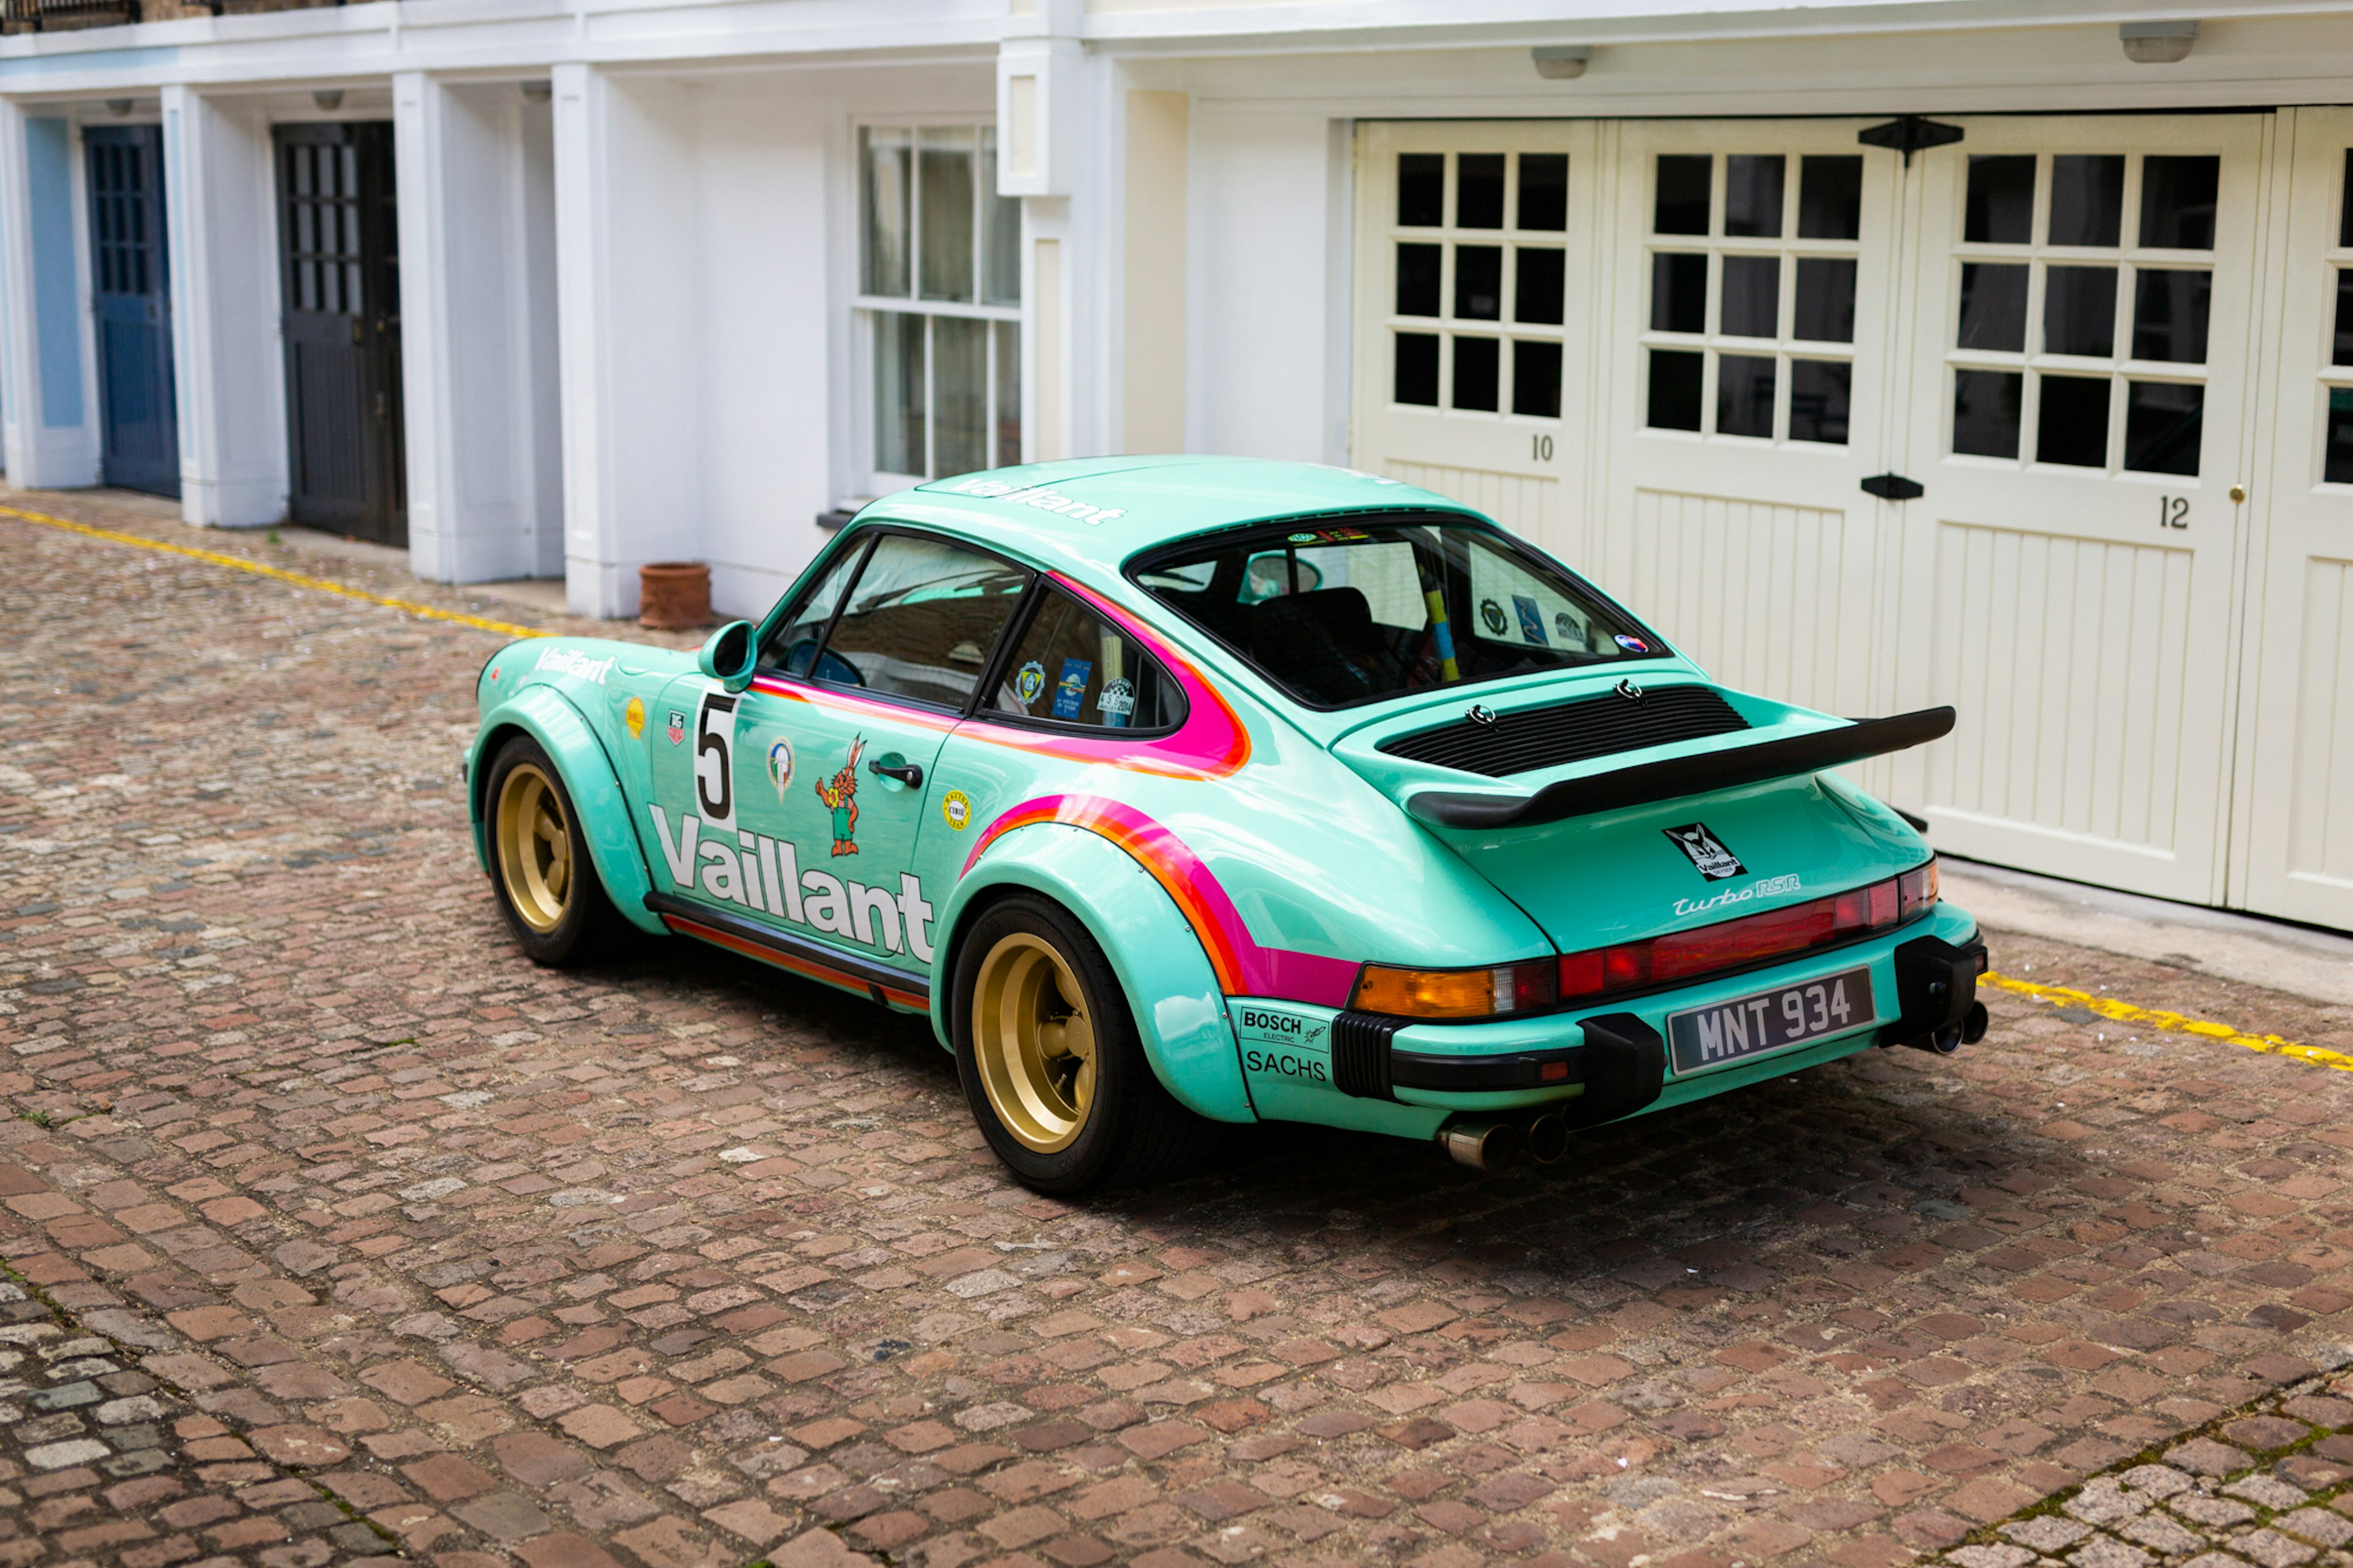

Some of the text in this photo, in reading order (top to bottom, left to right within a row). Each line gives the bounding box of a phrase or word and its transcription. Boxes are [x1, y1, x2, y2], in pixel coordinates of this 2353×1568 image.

[1533, 434, 1553, 461] 10
[949, 479, 1128, 526] Vaillant
[2161, 496, 2189, 529] 12
[534, 646, 615, 684] Vaillant
[1107, 694, 1112, 704] 5
[1118, 700, 1132, 711] 2014
[627, 710, 642, 724] SHELL
[697, 692, 736, 820] 5
[1699, 858, 1738, 871] Vaillant
[647, 802, 934, 965] Vaillant
[1756, 874, 1801, 898] RSR
[1245, 1012, 1302, 1034] BOSCH
[1697, 979, 1851, 1061] MNT 934
[1264, 1032, 1295, 1043] ELECTRIC
[1246, 1051, 1326, 1081] SACHS
